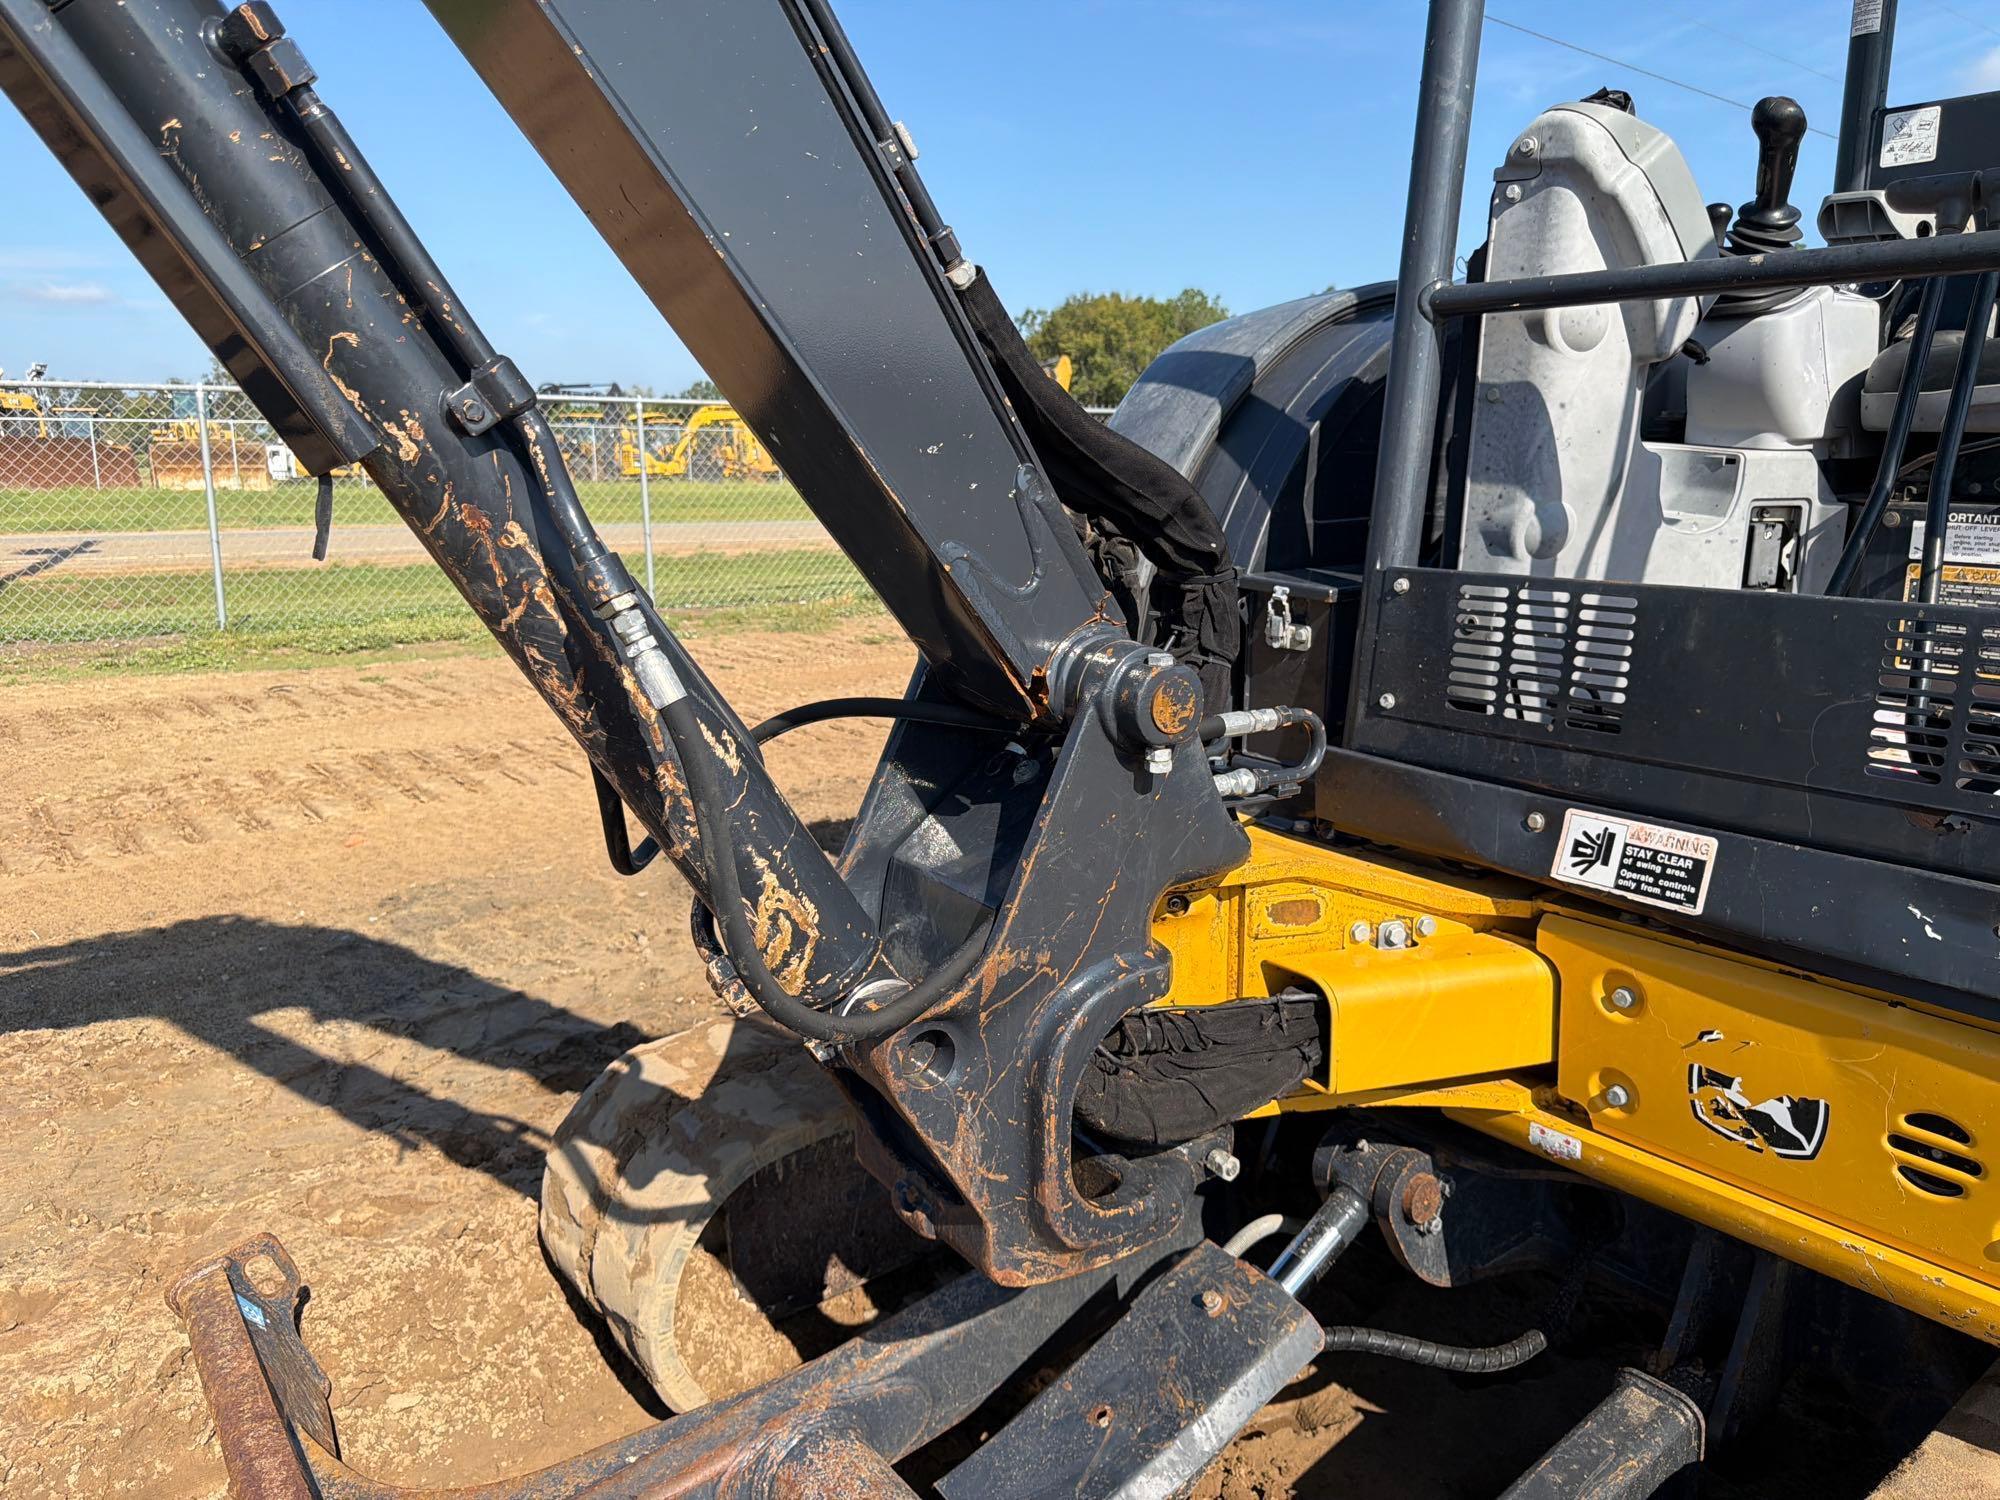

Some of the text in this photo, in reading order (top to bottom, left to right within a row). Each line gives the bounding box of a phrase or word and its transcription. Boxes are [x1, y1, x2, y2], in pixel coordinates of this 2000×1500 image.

[1948, 512, 2000, 523] ORTANT
[1644, 831, 1711, 856] WARNING
[1623, 857, 1688, 878] of swing area.
[1625, 845, 1693, 870] STAY CLEAR
[1618, 878, 1687, 901] only from seat.
[1620, 868, 1696, 894] Operate controls
